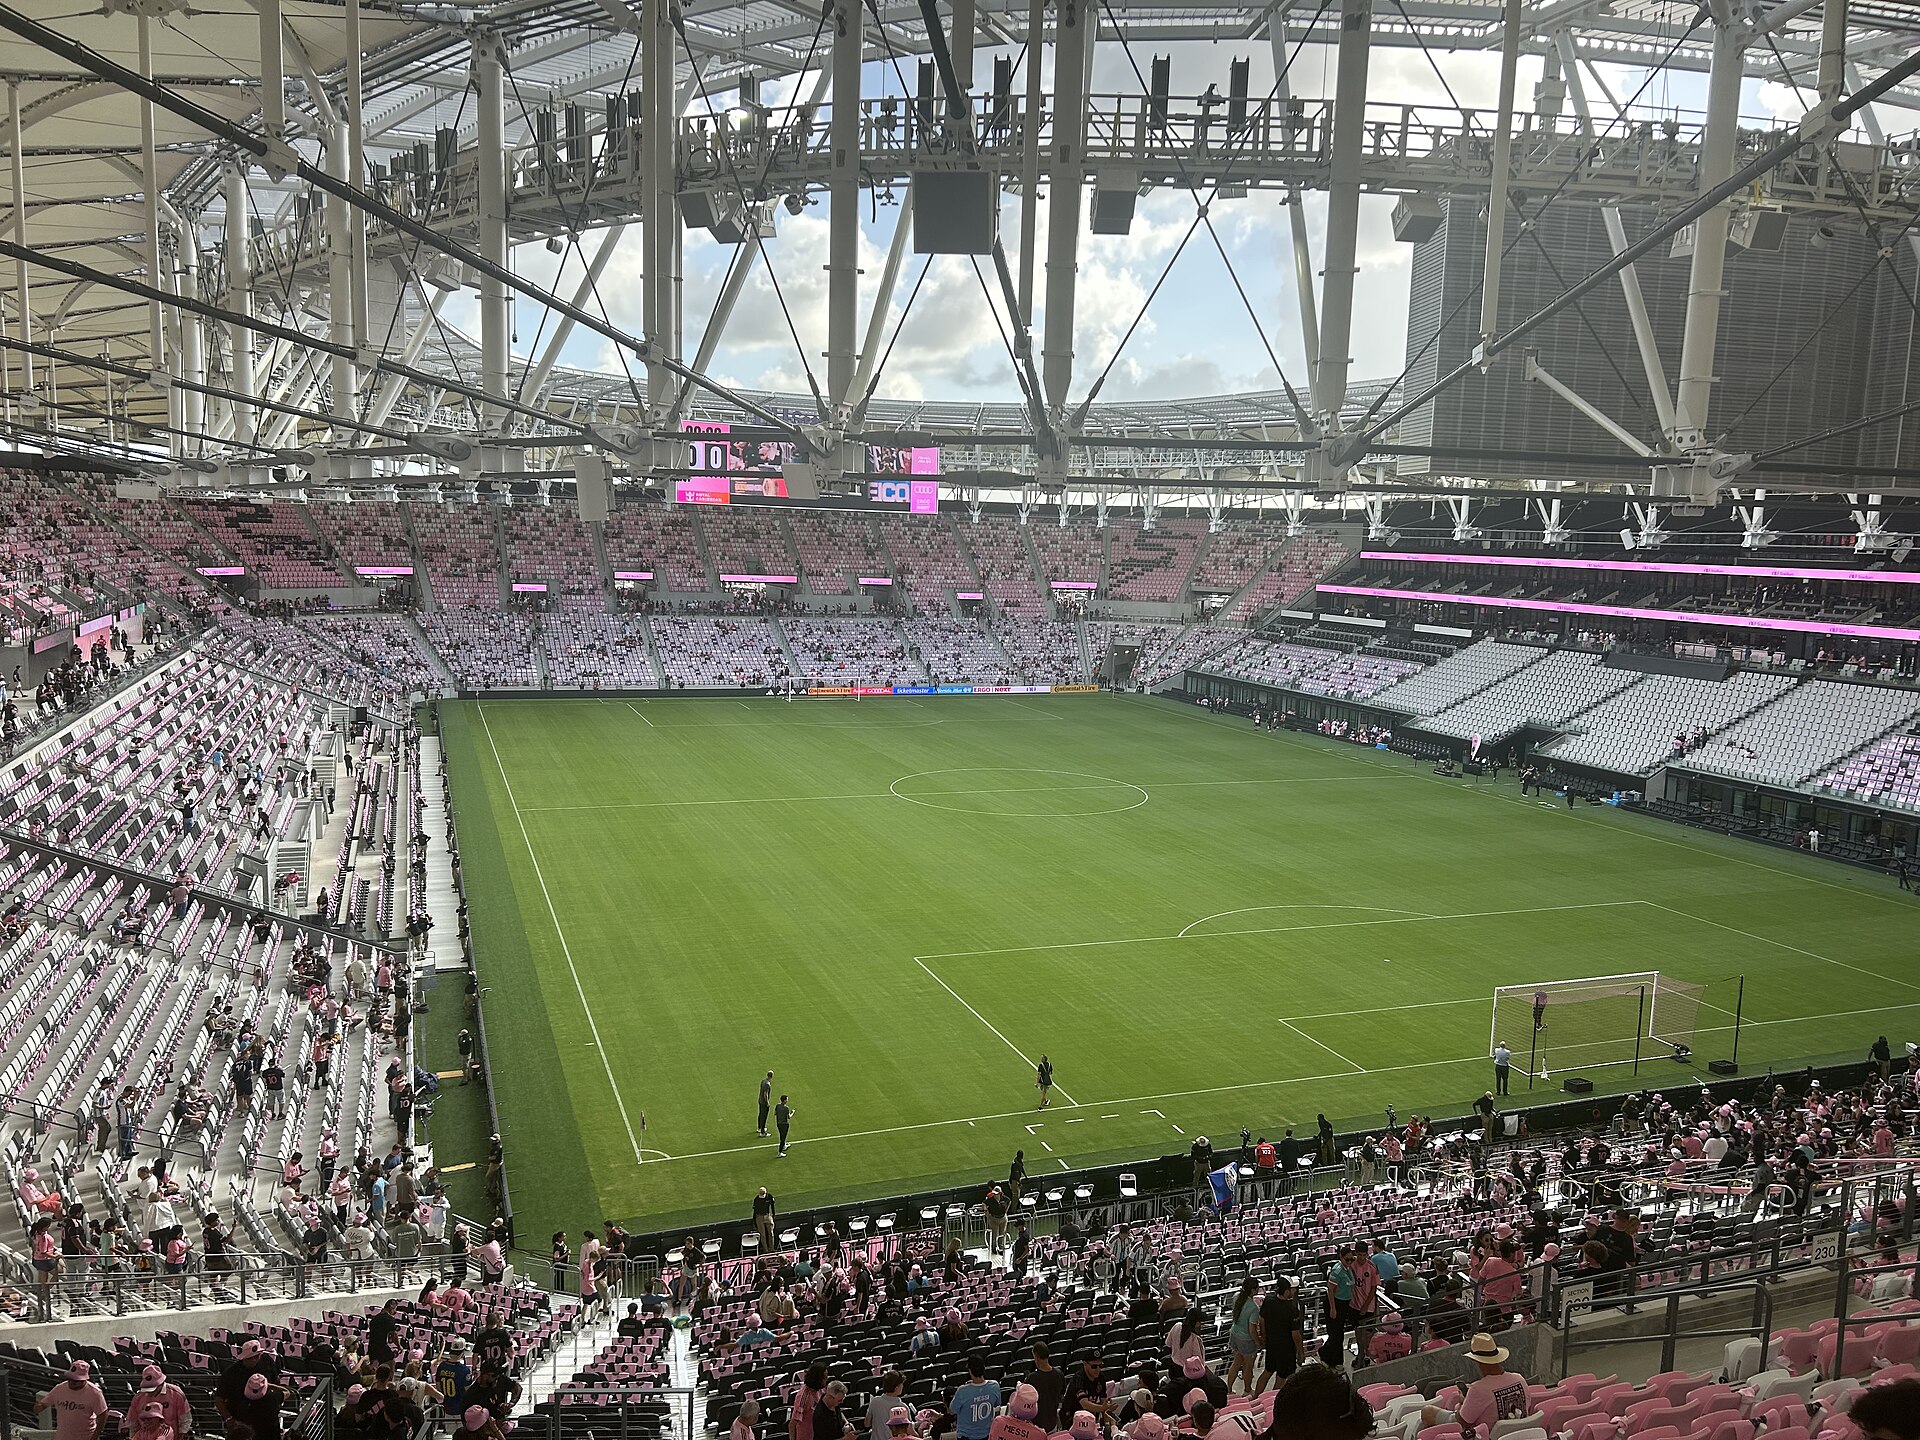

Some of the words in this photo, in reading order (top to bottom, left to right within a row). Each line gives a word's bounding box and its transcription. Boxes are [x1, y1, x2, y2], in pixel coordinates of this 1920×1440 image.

[710, 446, 722, 468] 0
[1817, 1236, 1835, 1244] SECTION
[1814, 1246, 1835, 1260] 230
[1567, 1288, 1589, 1296] SECTION
[484, 1346, 502, 1359] 10
[441, 1379, 456, 1397] 10
[970, 1402, 992, 1422] 10
[1004, 1424, 1030, 1438] MESSI
